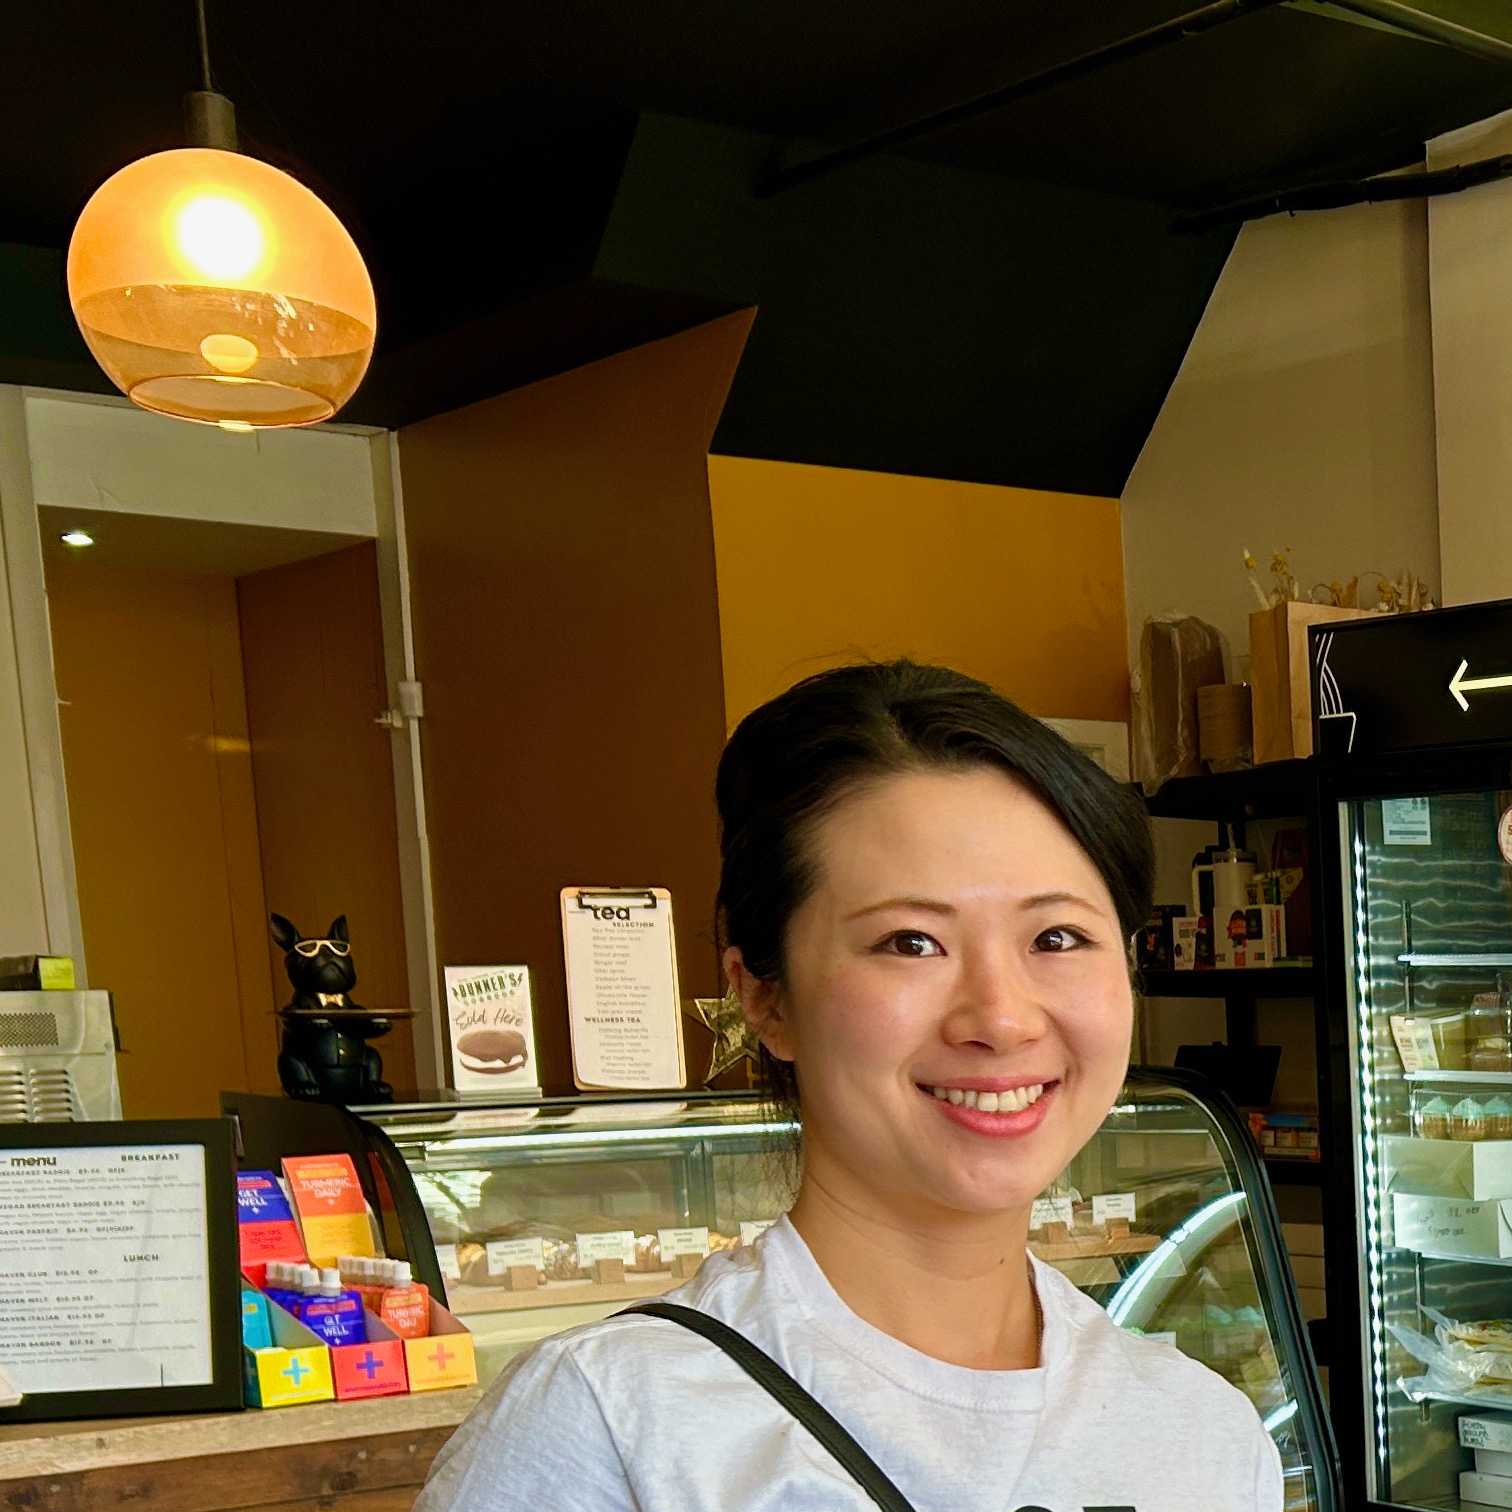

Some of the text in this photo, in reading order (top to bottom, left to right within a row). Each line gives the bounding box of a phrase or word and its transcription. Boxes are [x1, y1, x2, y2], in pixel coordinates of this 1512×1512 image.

[592, 906, 630, 920] tea
[10, 1156, 56, 1166] menu
[121, 1154, 180, 1162] BREAKFAST
[237, 1198, 268, 1207] WELL
[123, 1254, 159, 1262] LUNCH
[323, 1324, 349, 1337] WELL
